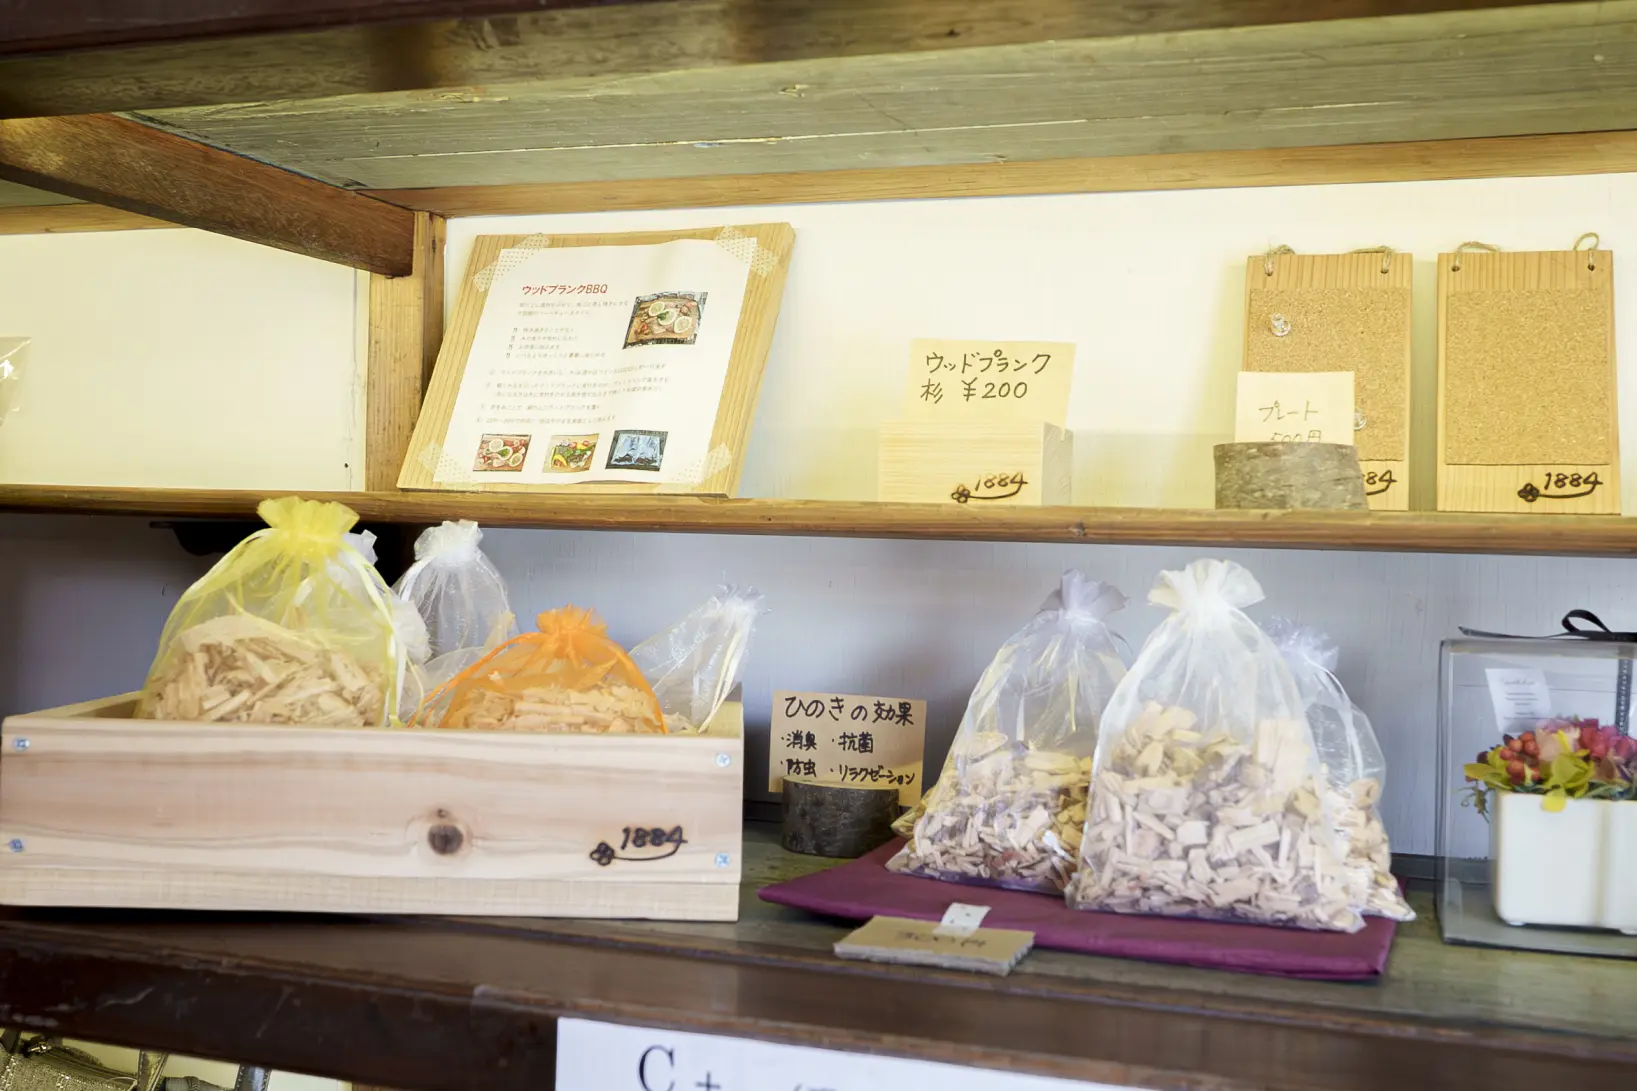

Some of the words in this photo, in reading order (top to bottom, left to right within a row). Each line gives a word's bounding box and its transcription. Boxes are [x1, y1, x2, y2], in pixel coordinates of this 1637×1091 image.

[925, 348, 1052, 375] ウッドプランク
[920, 378, 944, 404] 杉
[1258, 400, 1319, 423] プレート
[973, 470, 1029, 498] 1884
[1543, 471, 1604, 497] 1884
[784, 695, 914, 726] ひのきの効果
[618, 825, 689, 860] 1884
